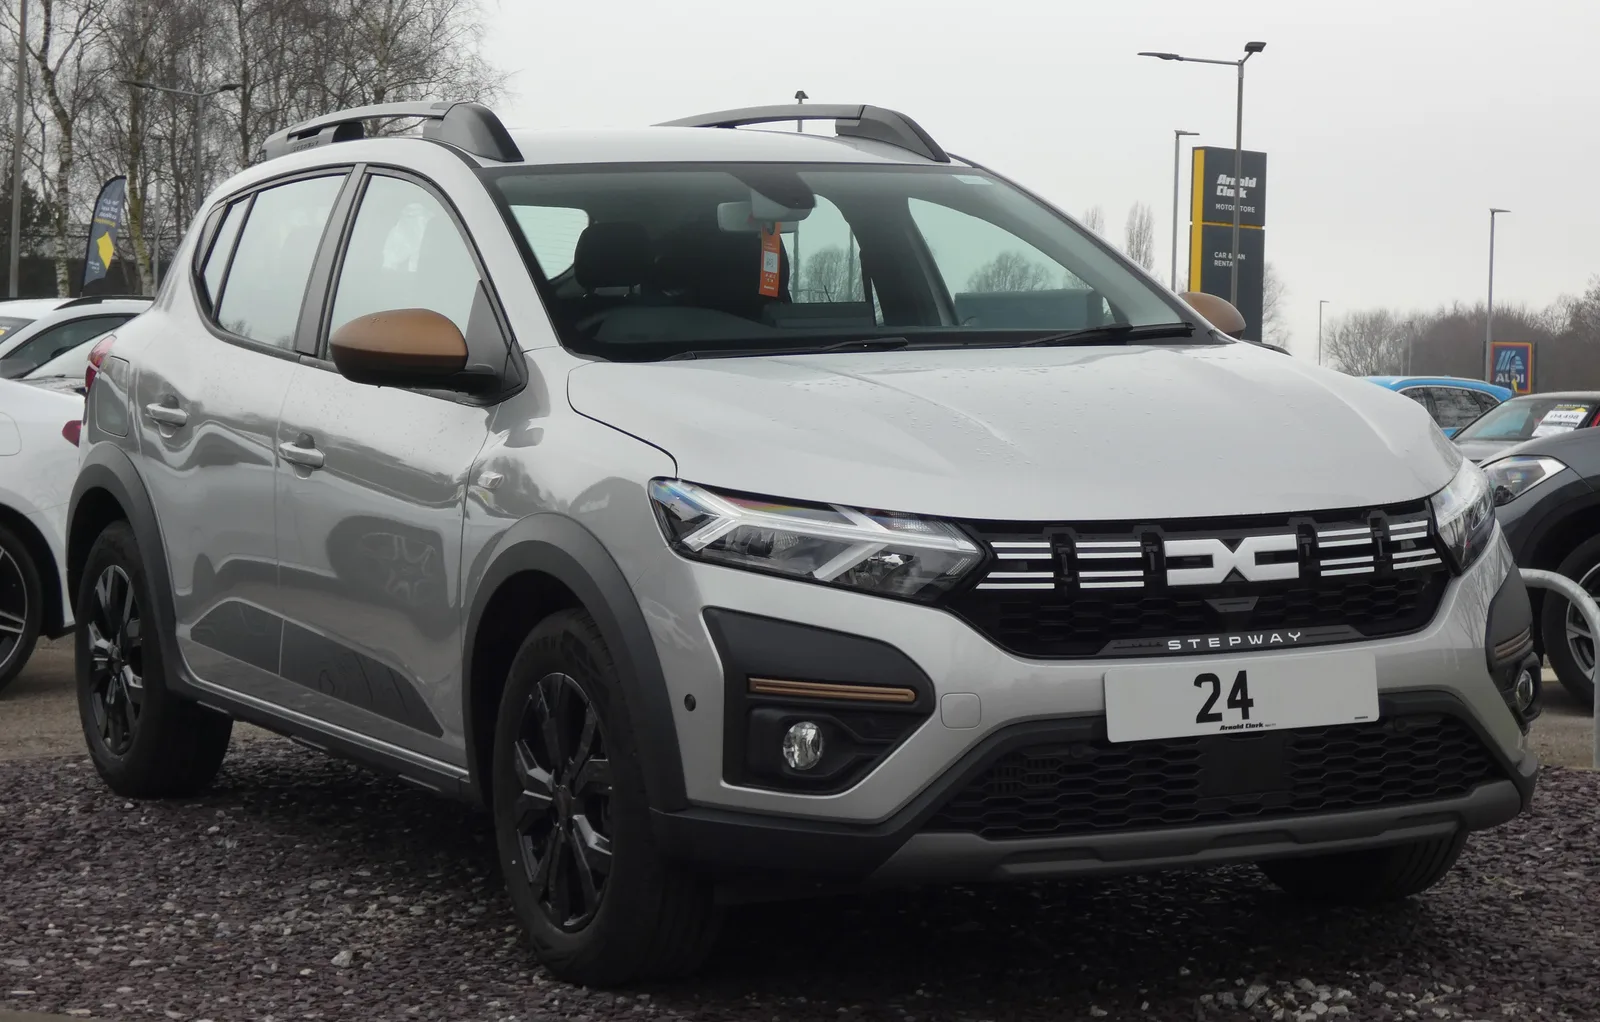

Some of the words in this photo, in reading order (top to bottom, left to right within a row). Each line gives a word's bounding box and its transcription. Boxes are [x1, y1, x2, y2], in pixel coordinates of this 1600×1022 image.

[1216, 185, 1248, 198] Clak
[1215, 203, 1256, 213] MOTOTORE
[1214, 251, 1227, 259] CAR
[1214, 259, 1234, 267] RENTA
[1167, 631, 1301, 650] STEPWAY
[1193, 669, 1254, 724] 24
[1219, 723, 1244, 731] Arnold
[1245, 721, 1264, 729] Clark
